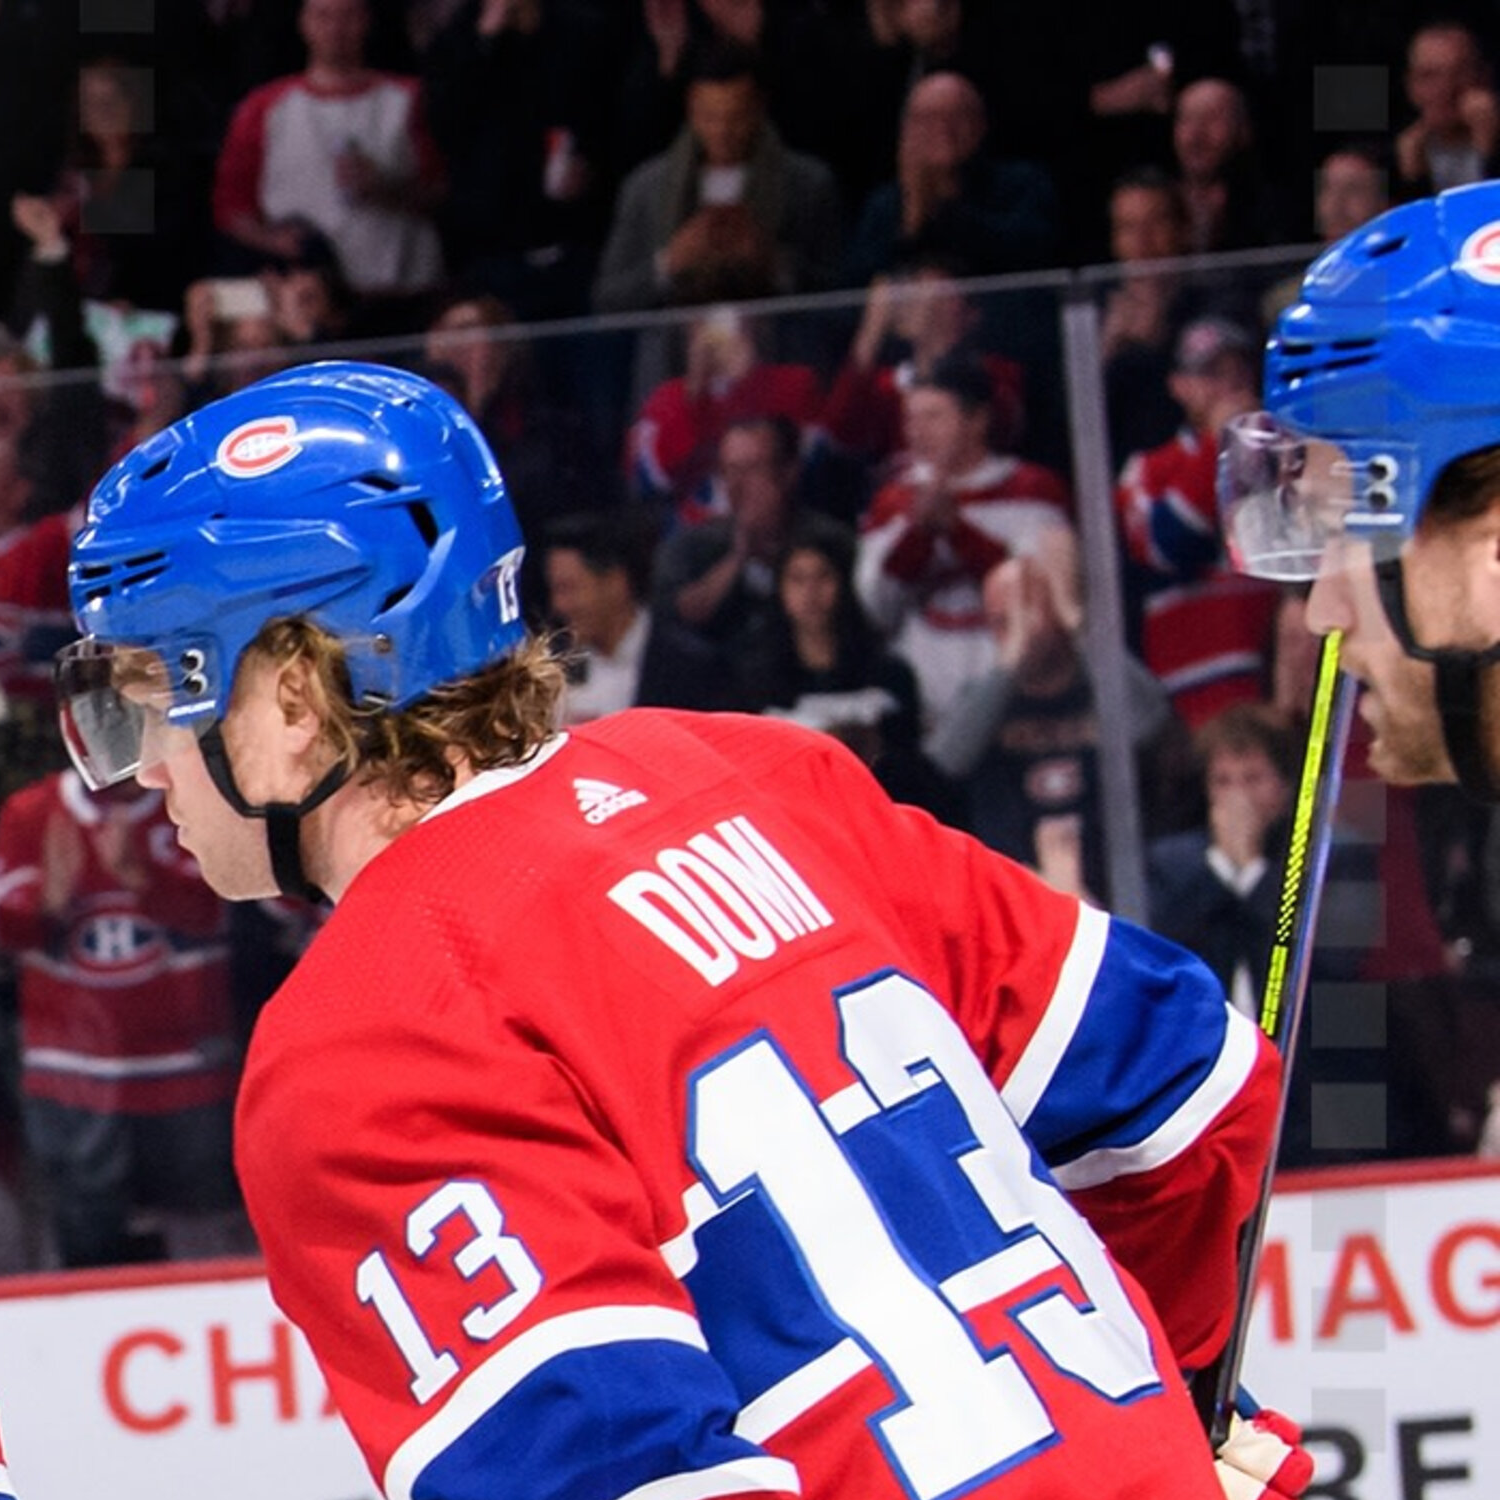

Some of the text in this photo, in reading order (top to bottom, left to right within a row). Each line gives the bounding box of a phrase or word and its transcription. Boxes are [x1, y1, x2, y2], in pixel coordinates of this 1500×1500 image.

[608, 815, 834, 986] DOMI
[102, 1318, 340, 1436] CH
[354, 1178, 545, 1405] 13
